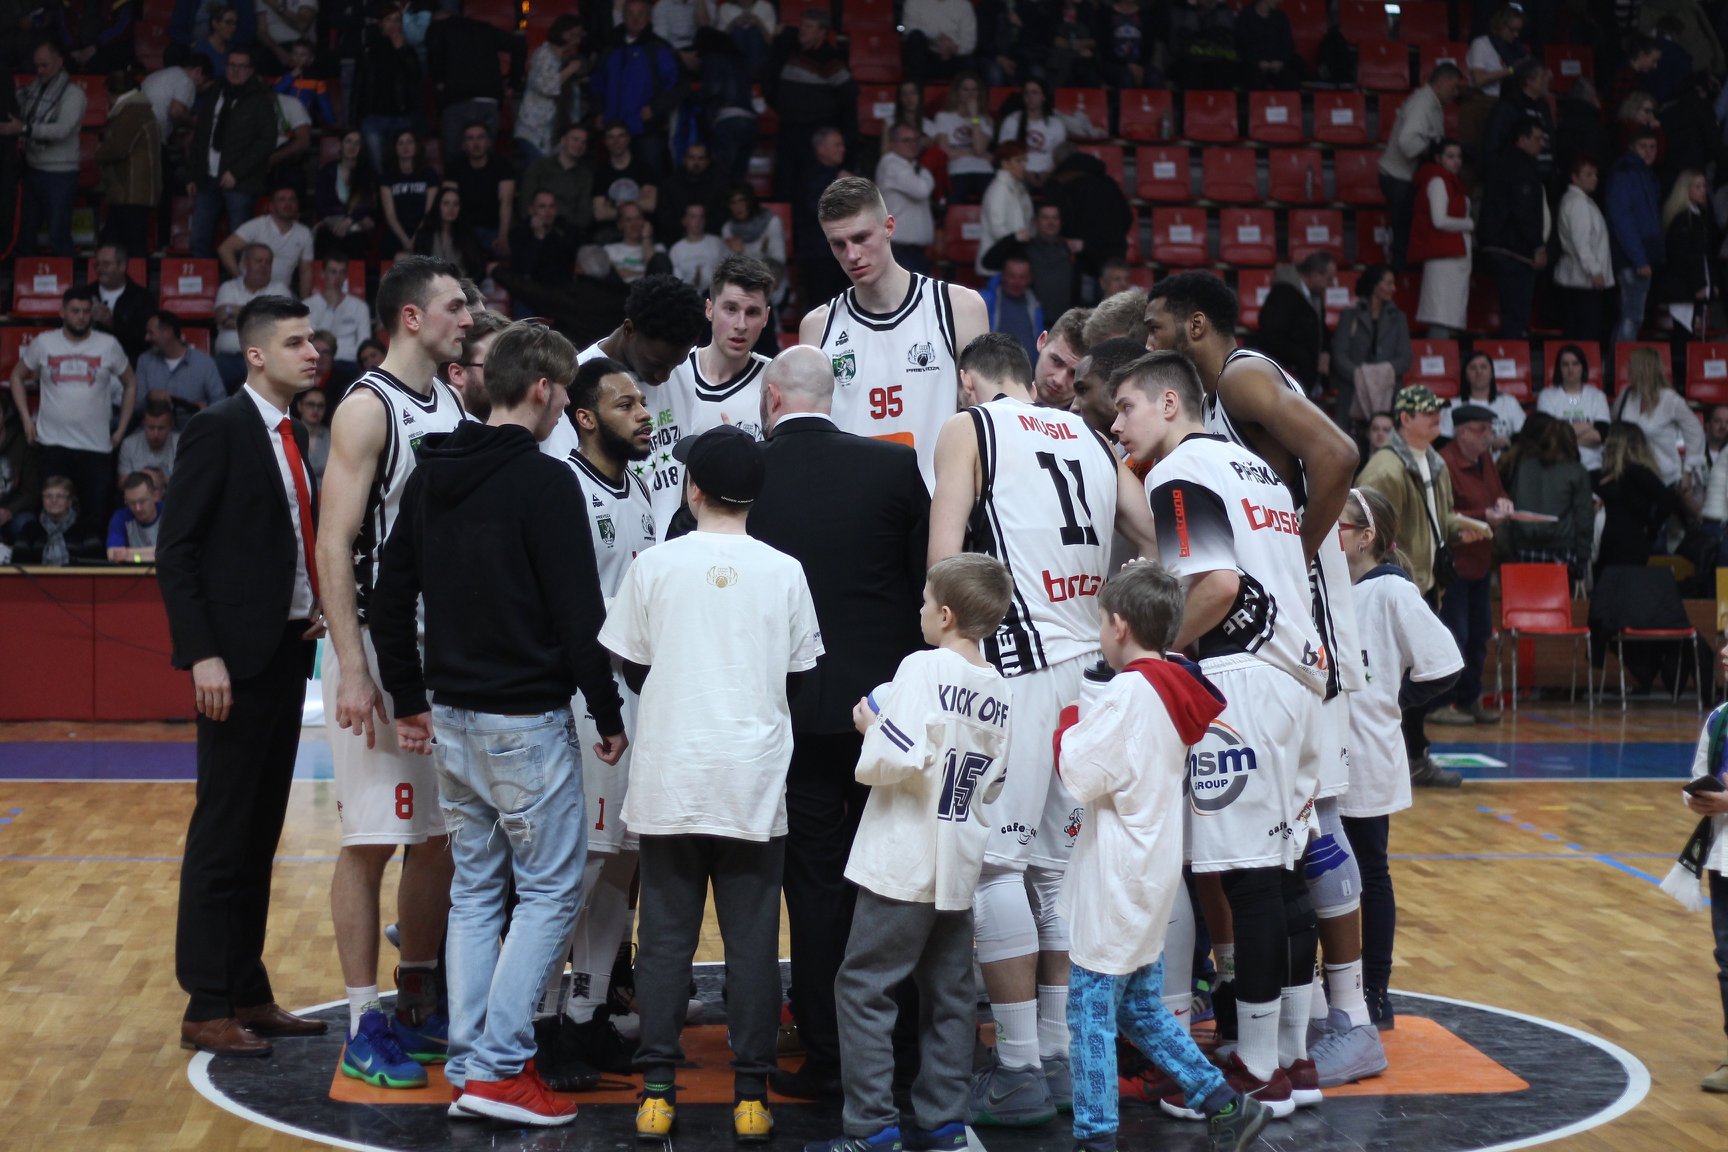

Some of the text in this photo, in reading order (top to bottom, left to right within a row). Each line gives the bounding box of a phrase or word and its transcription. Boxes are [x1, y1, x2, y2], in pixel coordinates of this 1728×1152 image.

[869, 385, 904, 420] 95
[1018, 415, 1078, 440] MUSIL
[1035, 451, 1100, 546] 11
[938, 684, 1009, 728] KICK OFF
[395, 783, 414, 820] 8
[938, 748, 994, 823] 15
[595, 797, 605, 831] 1
[1001, 822, 1026, 835] cafe
